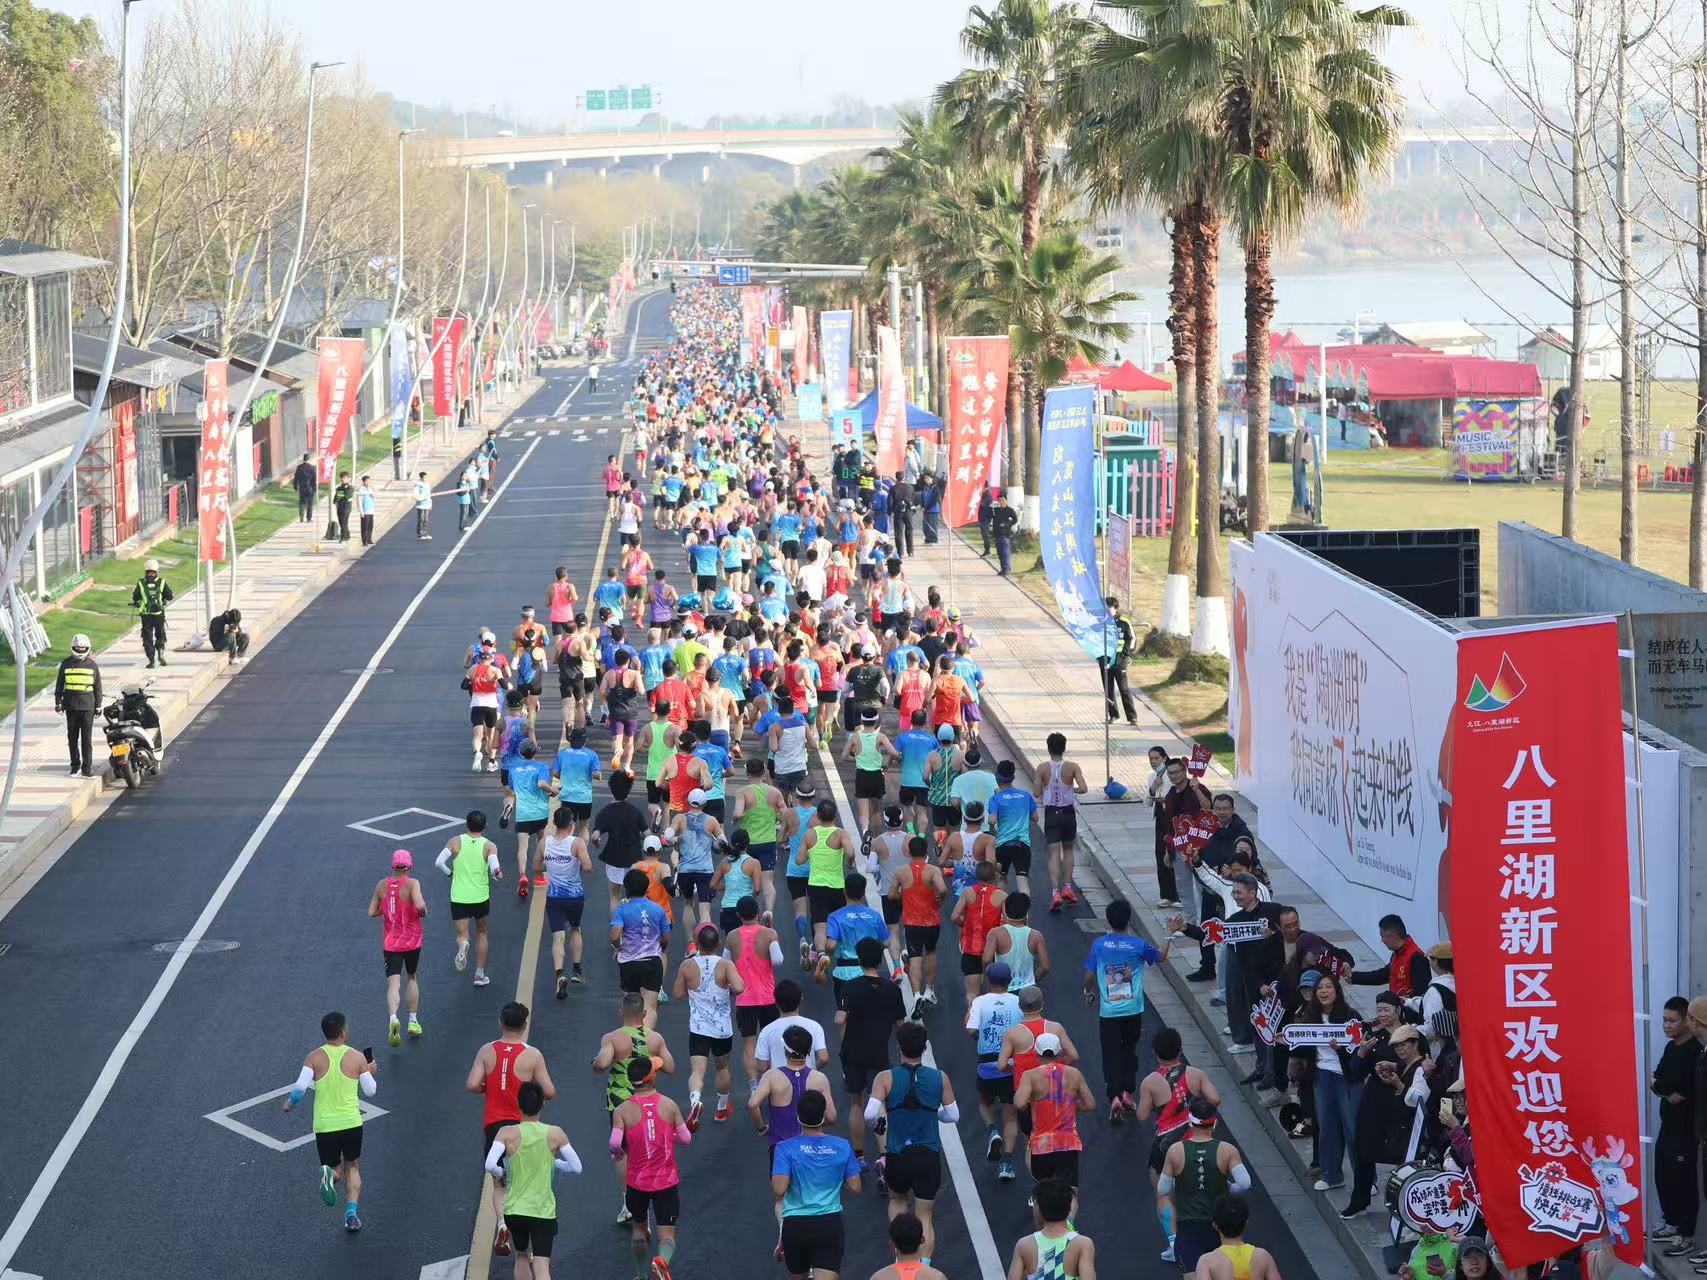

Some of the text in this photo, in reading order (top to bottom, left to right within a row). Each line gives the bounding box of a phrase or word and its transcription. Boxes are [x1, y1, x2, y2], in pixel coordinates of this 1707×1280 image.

[843, 418, 854, 435] 5
[1457, 432, 1491, 443] MUSIC
[1461, 441, 1511, 452] FESTIVAL
[1499, 744, 1578, 1158] 八里湖新区欢迎您
[1537, 1183, 1593, 1214] 撞线挑战赛
[1534, 1197, 1583, 1222] 快乐第一
